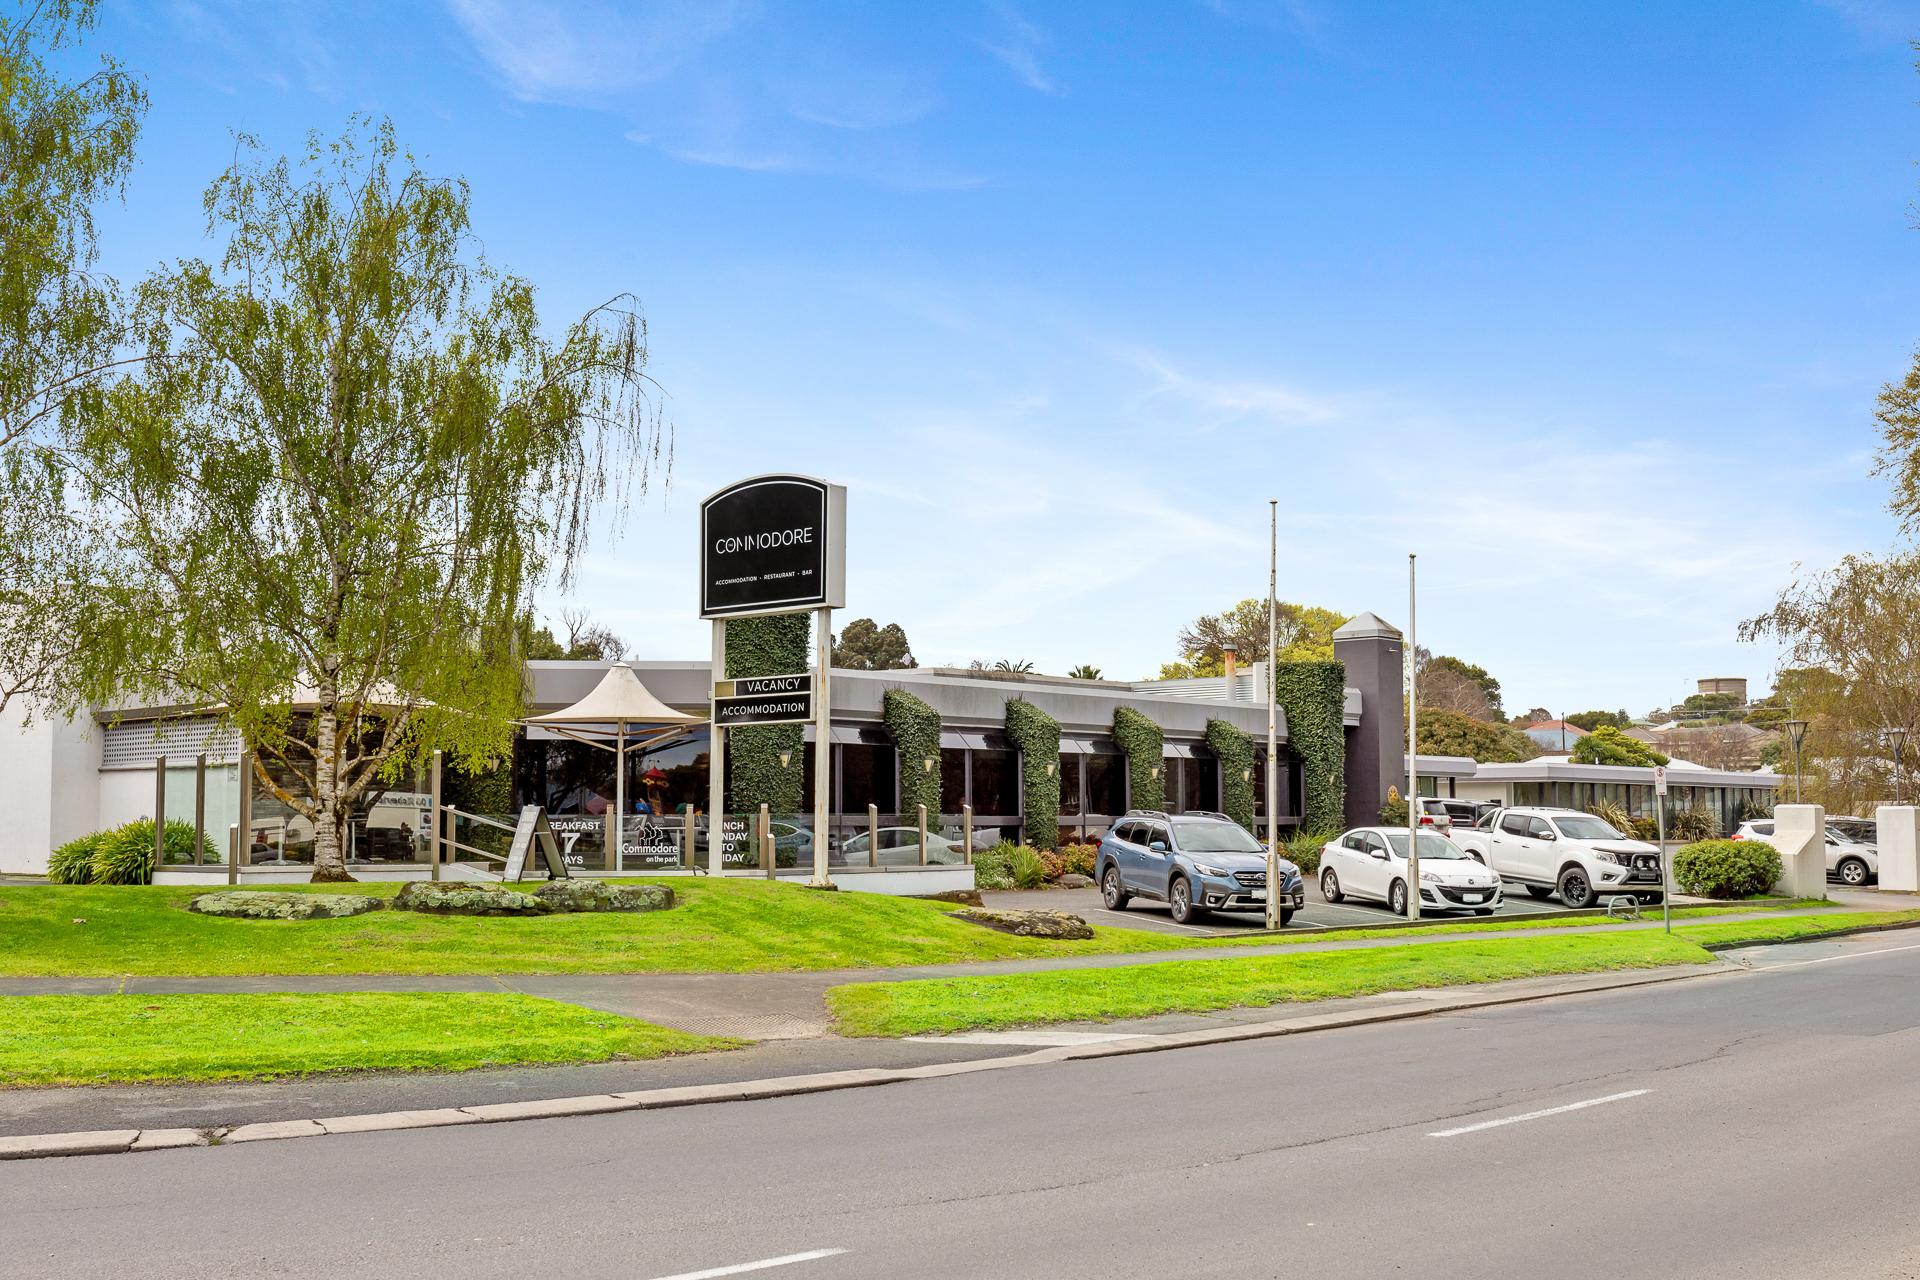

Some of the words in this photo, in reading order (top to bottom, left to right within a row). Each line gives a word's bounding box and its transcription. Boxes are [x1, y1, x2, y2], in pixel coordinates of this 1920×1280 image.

[715, 526, 813, 555] COMMODORE
[715, 575, 758, 586] ACCOMMODATION
[763, 571, 796, 580] RESTAURANT
[746, 678, 801, 692] VACANCY
[721, 702, 805, 716] ACCOMMODATION
[549, 821, 601, 830] REAKFAST
[723, 821, 744, 830] NCH
[561, 832, 581, 854] 7
[622, 842, 678, 853] Commodore
[721, 843, 734, 852] TO
[561, 855, 584, 865] AYS
[654, 855, 664, 863] the
[664, 855, 678, 864] park
[722, 853, 745, 862] IDAY
